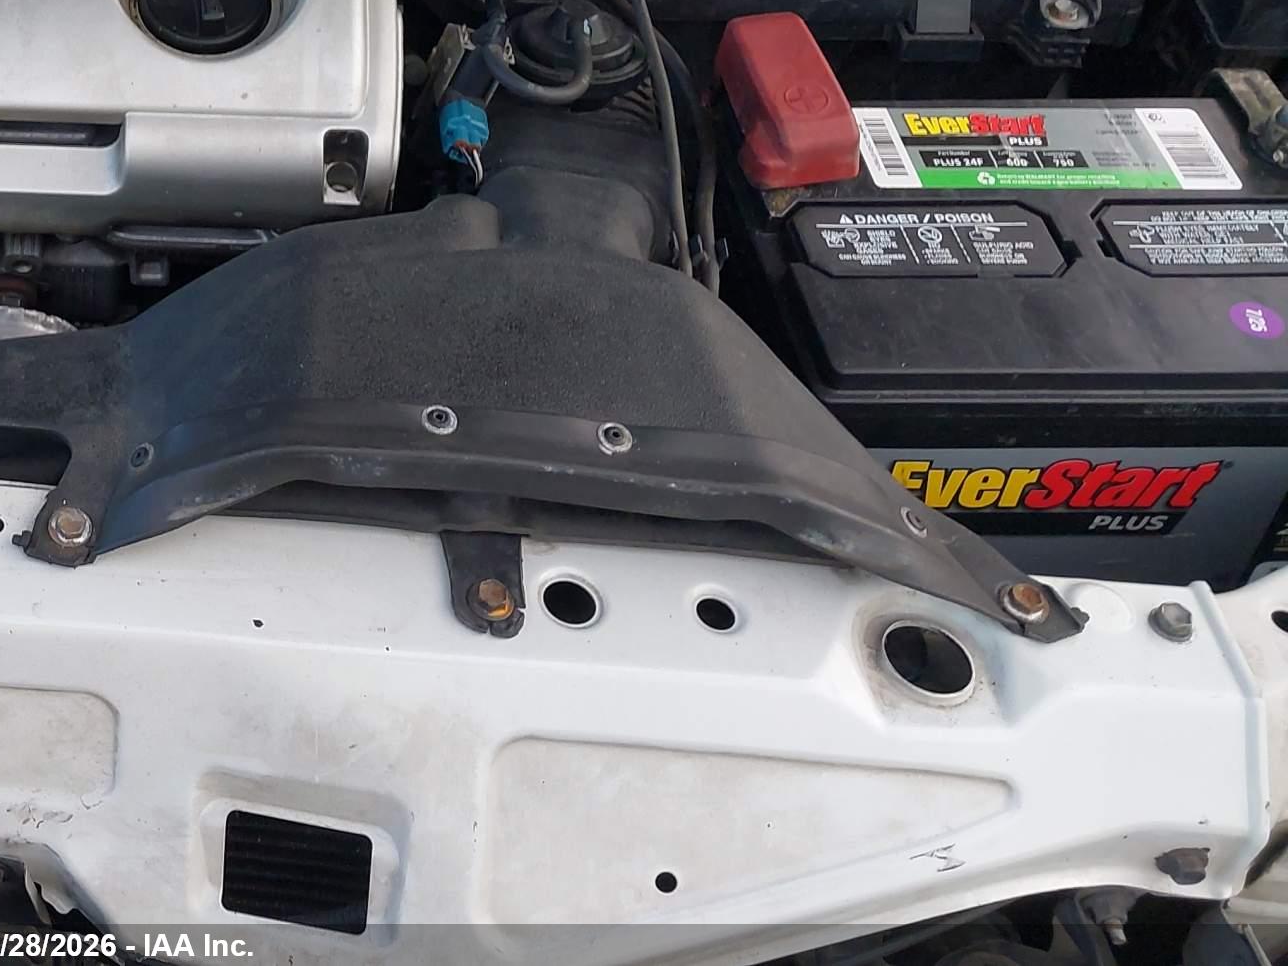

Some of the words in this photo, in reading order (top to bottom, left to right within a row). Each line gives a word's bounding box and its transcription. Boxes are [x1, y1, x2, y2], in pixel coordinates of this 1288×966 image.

[903, 112, 1047, 136] EverStart
[1009, 136, 1043, 146] PLUS
[933, 157, 962, 167] PLUS
[854, 213, 919, 224] DANGER
[934, 213, 995, 223] POISON
[1088, 515, 1169, 531] PLUS
